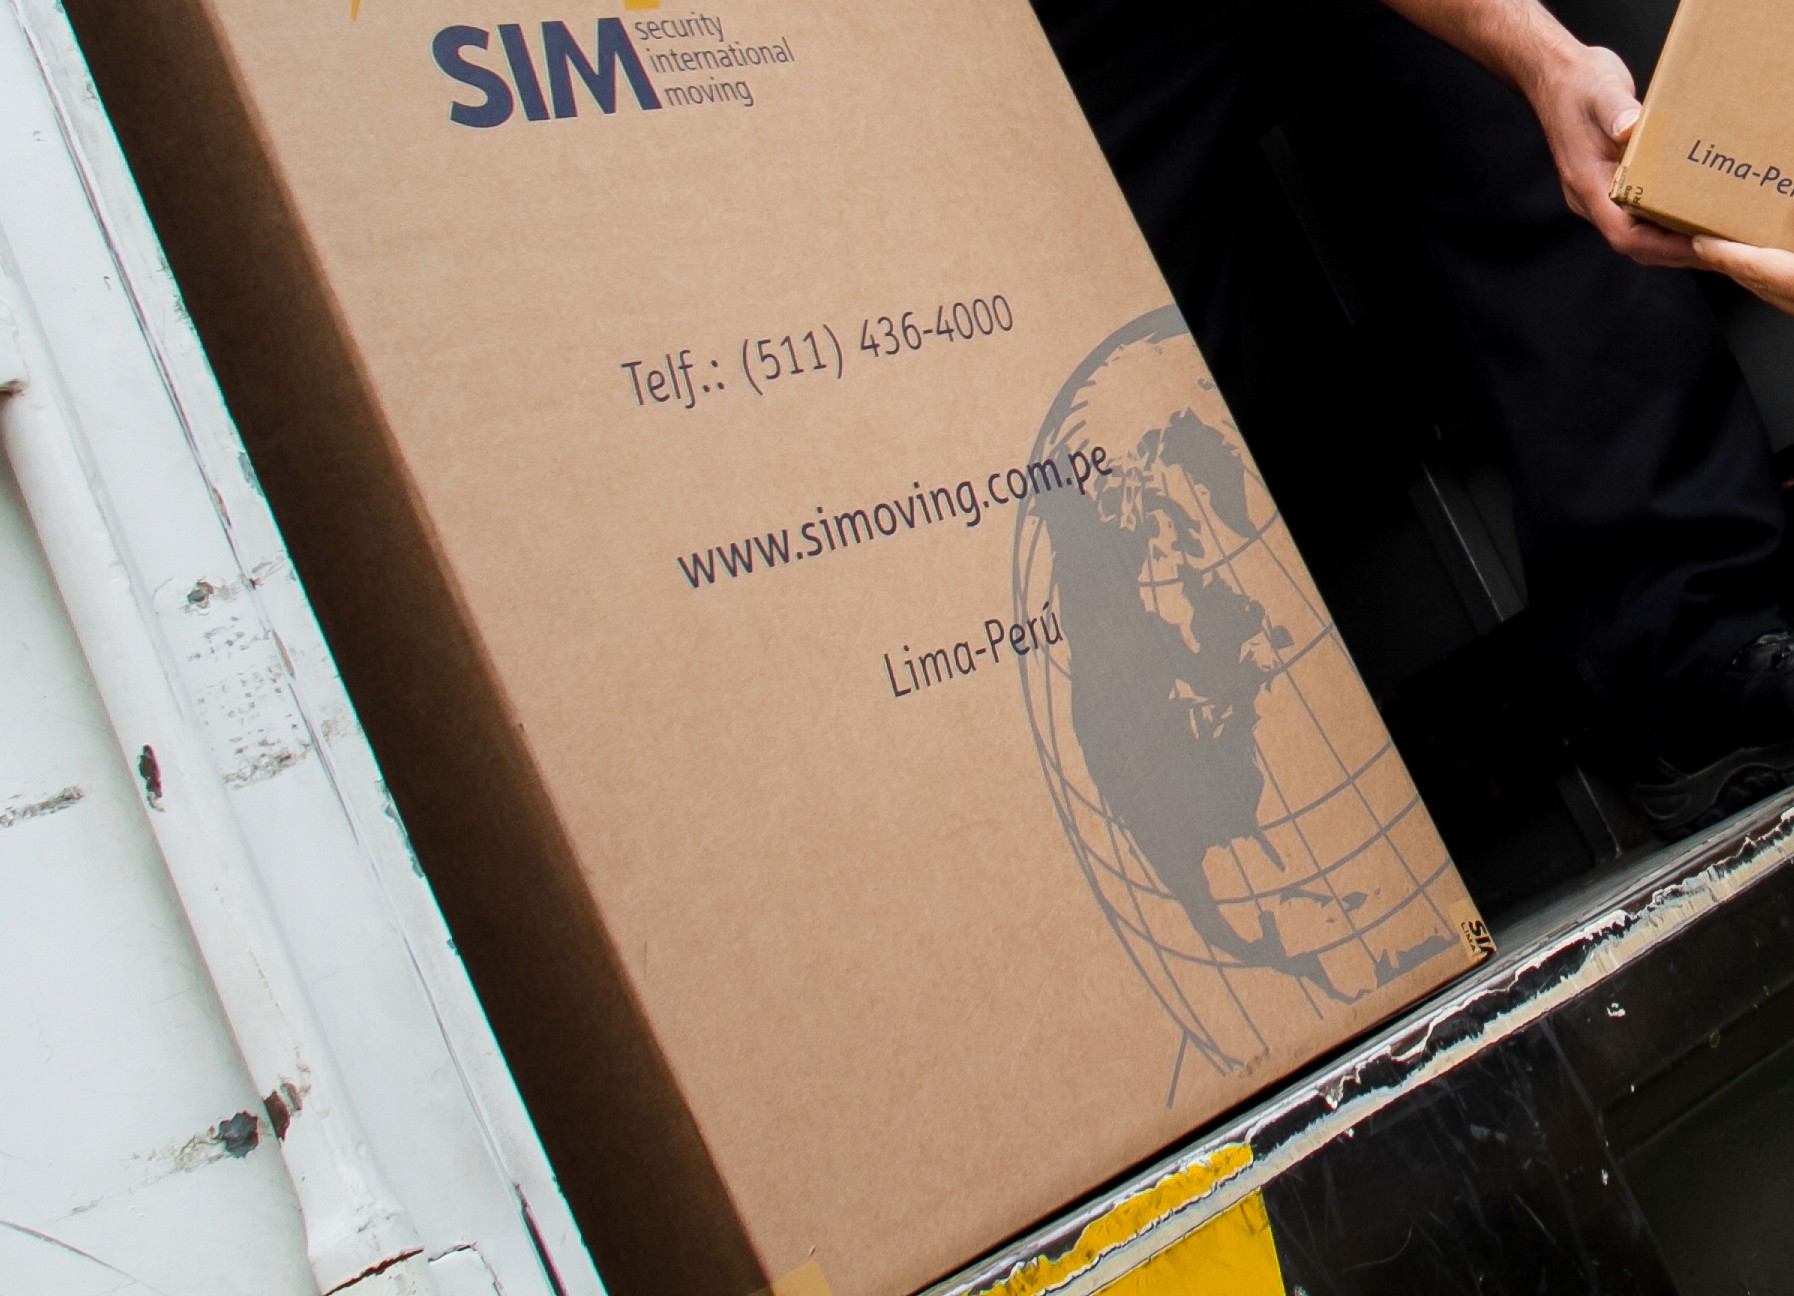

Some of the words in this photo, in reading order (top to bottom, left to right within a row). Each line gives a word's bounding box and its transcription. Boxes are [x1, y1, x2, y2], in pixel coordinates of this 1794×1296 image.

[634, 11, 725, 42] security
[648, 36, 796, 73] international
[431, 16, 663, 128] SIM
[663, 77, 755, 109] moving
[621, 349, 726, 409] Telf.:
[741, 324, 845, 396] (511)
[859, 294, 1014, 358] 436-4000
[676, 445, 1114, 589] www.simoving.com.pe
[883, 601, 1064, 697] Lima-Perú
[1460, 921, 1477, 953] LIMA
